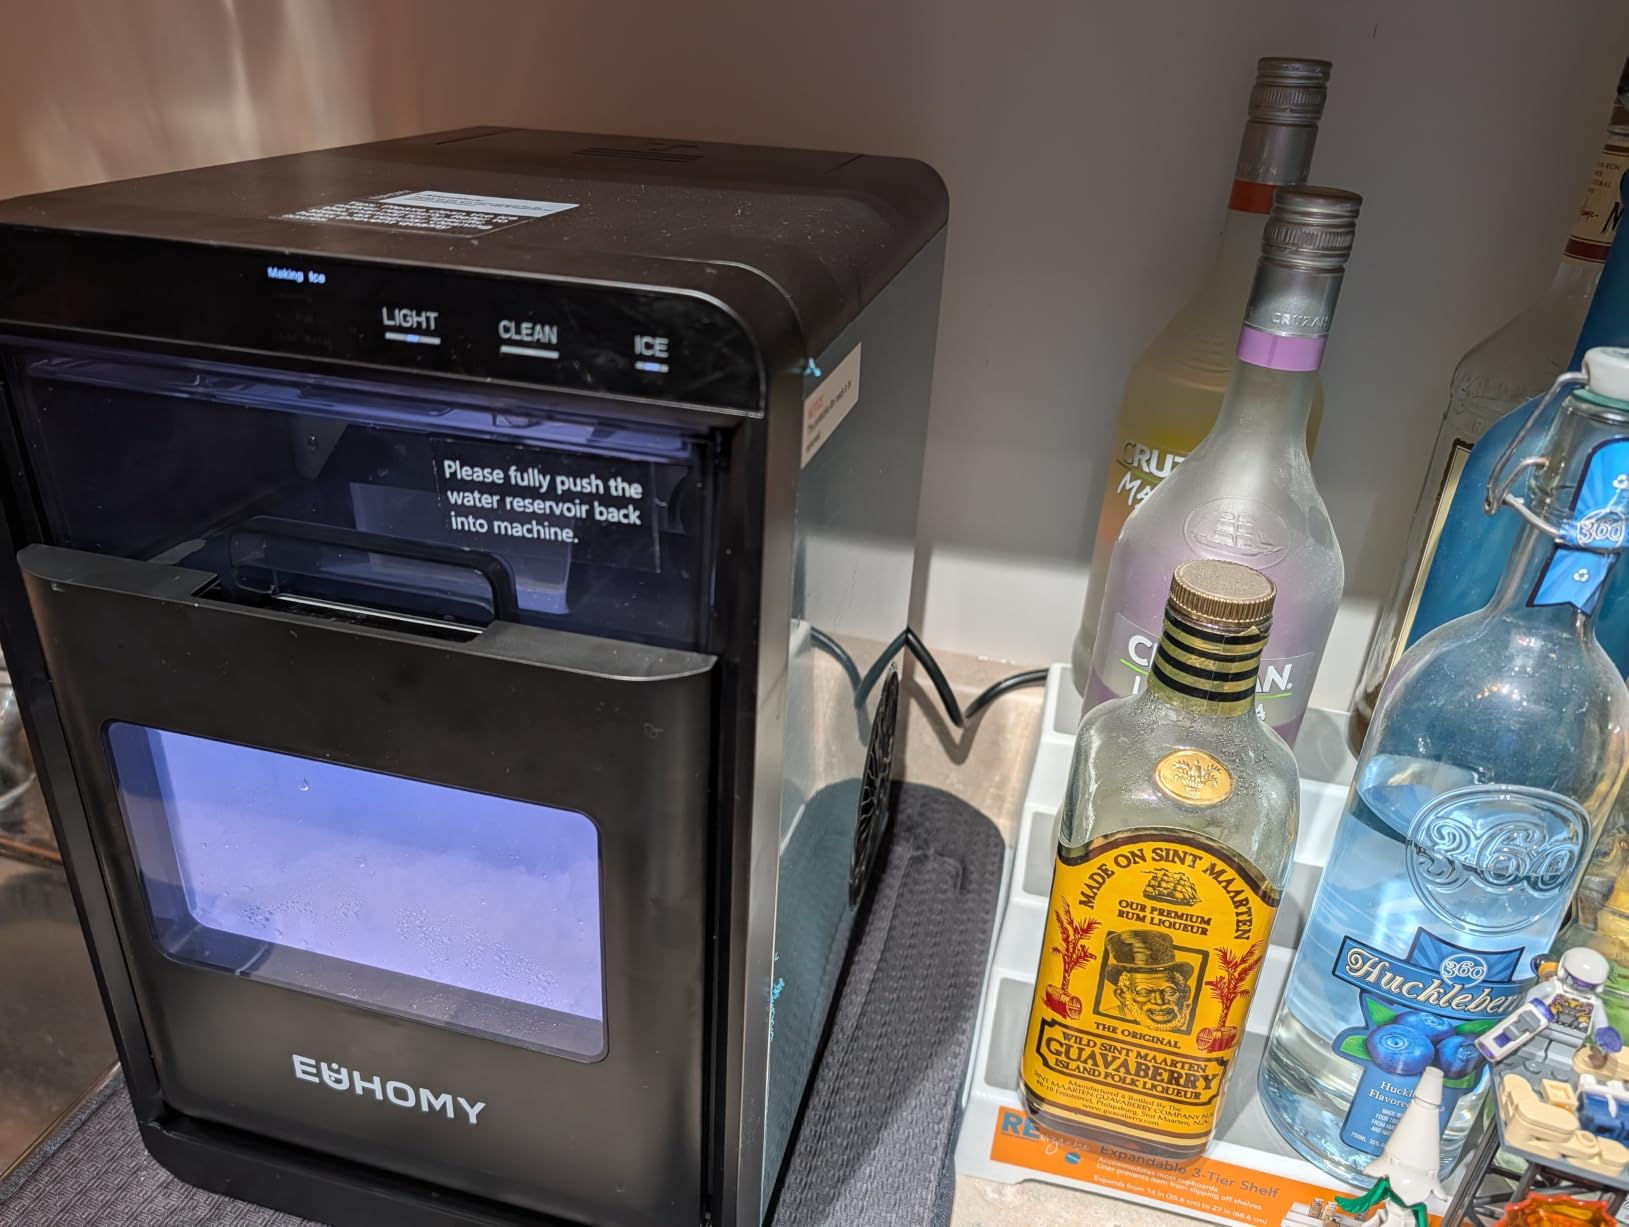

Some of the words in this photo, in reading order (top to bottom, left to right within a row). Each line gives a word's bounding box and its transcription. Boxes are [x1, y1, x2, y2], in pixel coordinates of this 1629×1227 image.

[267, 266, 304, 283] Making
[308, 270, 326, 284] Ice
[382, 306, 438, 330] LIGHT
[498, 319, 558, 344] CLEAN
[634, 335, 669, 358] ICE
[443, 459, 504, 483] Please
[508, 465, 550, 493] fully
[555, 474, 603, 495] push
[607, 477, 643, 499] the
[447, 489, 500, 509] water
[505, 496, 589, 518] reservoir
[594, 501, 642, 525] back
[450, 511, 488, 533] into
[493, 519, 579, 543] machine.
[1579, 519, 1622, 544] 360
[1078, 863, 1116, 910] MADE
[1113, 848, 1147, 868] ON
[1151, 847, 1202, 868] SINT
[1202, 862, 1254, 941] MAARTEN
[1117, 909, 1147, 924] RUM
[1149, 918, 1209, 936] LIQUEUR
[1118, 899, 1146, 913] OUR
[1149, 907, 1212, 926] PREMIUM
[1443, 960, 1485, 980] 360
[1094, 1021, 1119, 1035] THE
[1121, 1028, 1181, 1049] ORIGINAL
[1045, 1037, 1219, 1091] GUAVABERRY
[1061, 1030, 1097, 1048] WILD
[1100, 1042, 1132, 1057] SINT
[1135, 1050, 1208, 1074] MAARTEN
[292, 1054, 486, 1124] EUHOMY
[1054, 1057, 1101, 1078] ISLAND
[1103, 1071, 1141, 1089] FOLK
[1143, 1080, 1202, 1100] LIQUEUR
[1051, 1081, 1093, 1098] MAARTEN
[1096, 1094, 1152, 1112] GUAVABERRY
[1154, 1106, 1200, 1120] COMPANY
[1068, 1080, 1119, 1097] Manufactured
[1128, 1094, 1154, 1106] Bottled
[1168, 1104, 1182, 1112] The
[1141, 1110, 1155, 1119] Sint
[1093, 1174, 1125, 1187] Expands
[1127, 1182, 1145, 1192] from
[1096, 1163, 1114, 1172] Liner
[1116, 1168, 1149, 1181] prevents
[1170, 1180, 1188, 1191] from
[1190, 1186, 1219, 1200] slipping
[1234, 1199, 1262, 1210] shelves
[1101, 1146, 1186, 1174] Expandable
[1192, 1168, 1236, 1186] 3-Tier
[1240, 1180, 1280, 1198] Shelf
[1157, 1171, 1176, 1180] most
[1178, 1178, 1218, 1192] cupboards
